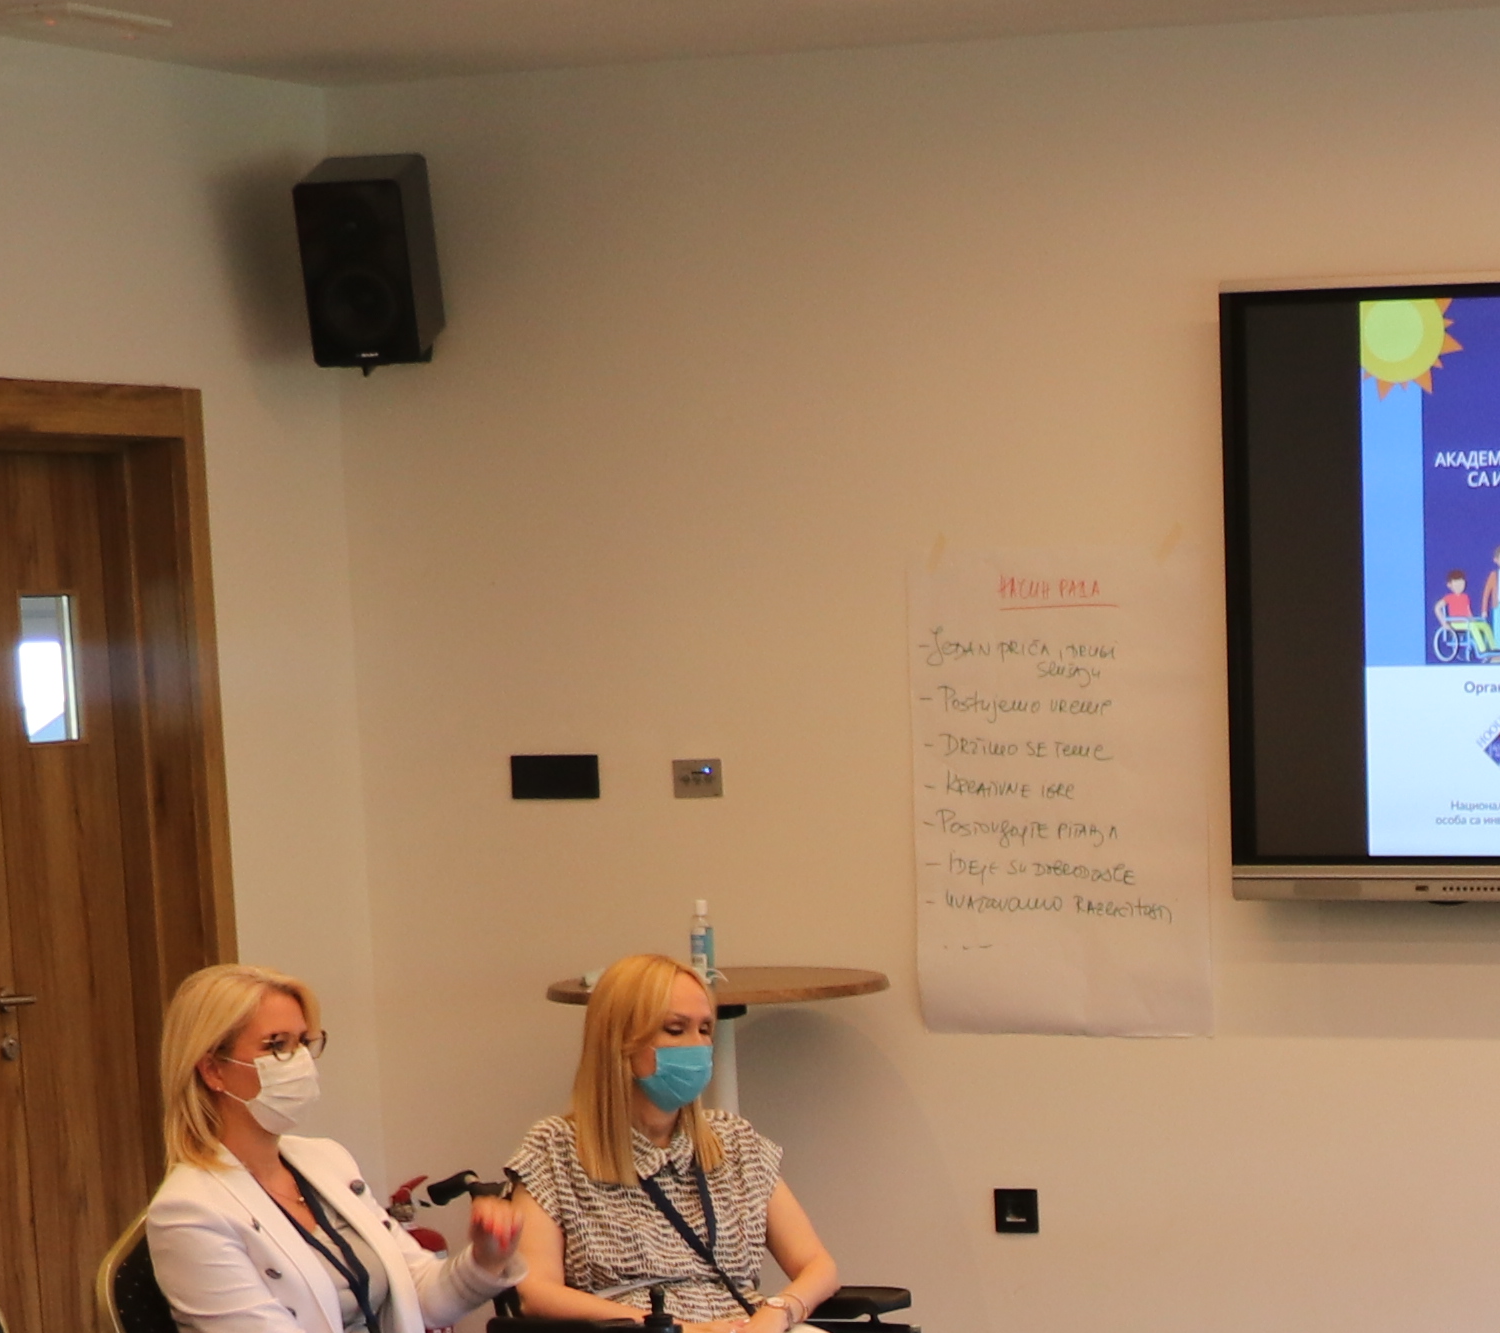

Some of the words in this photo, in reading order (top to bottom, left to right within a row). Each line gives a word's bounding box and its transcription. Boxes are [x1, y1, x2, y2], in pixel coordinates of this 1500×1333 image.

[1467, 470, 1490, 488] СА
[1435, 814, 1467, 826] особа
[1469, 815, 1481, 826] са
